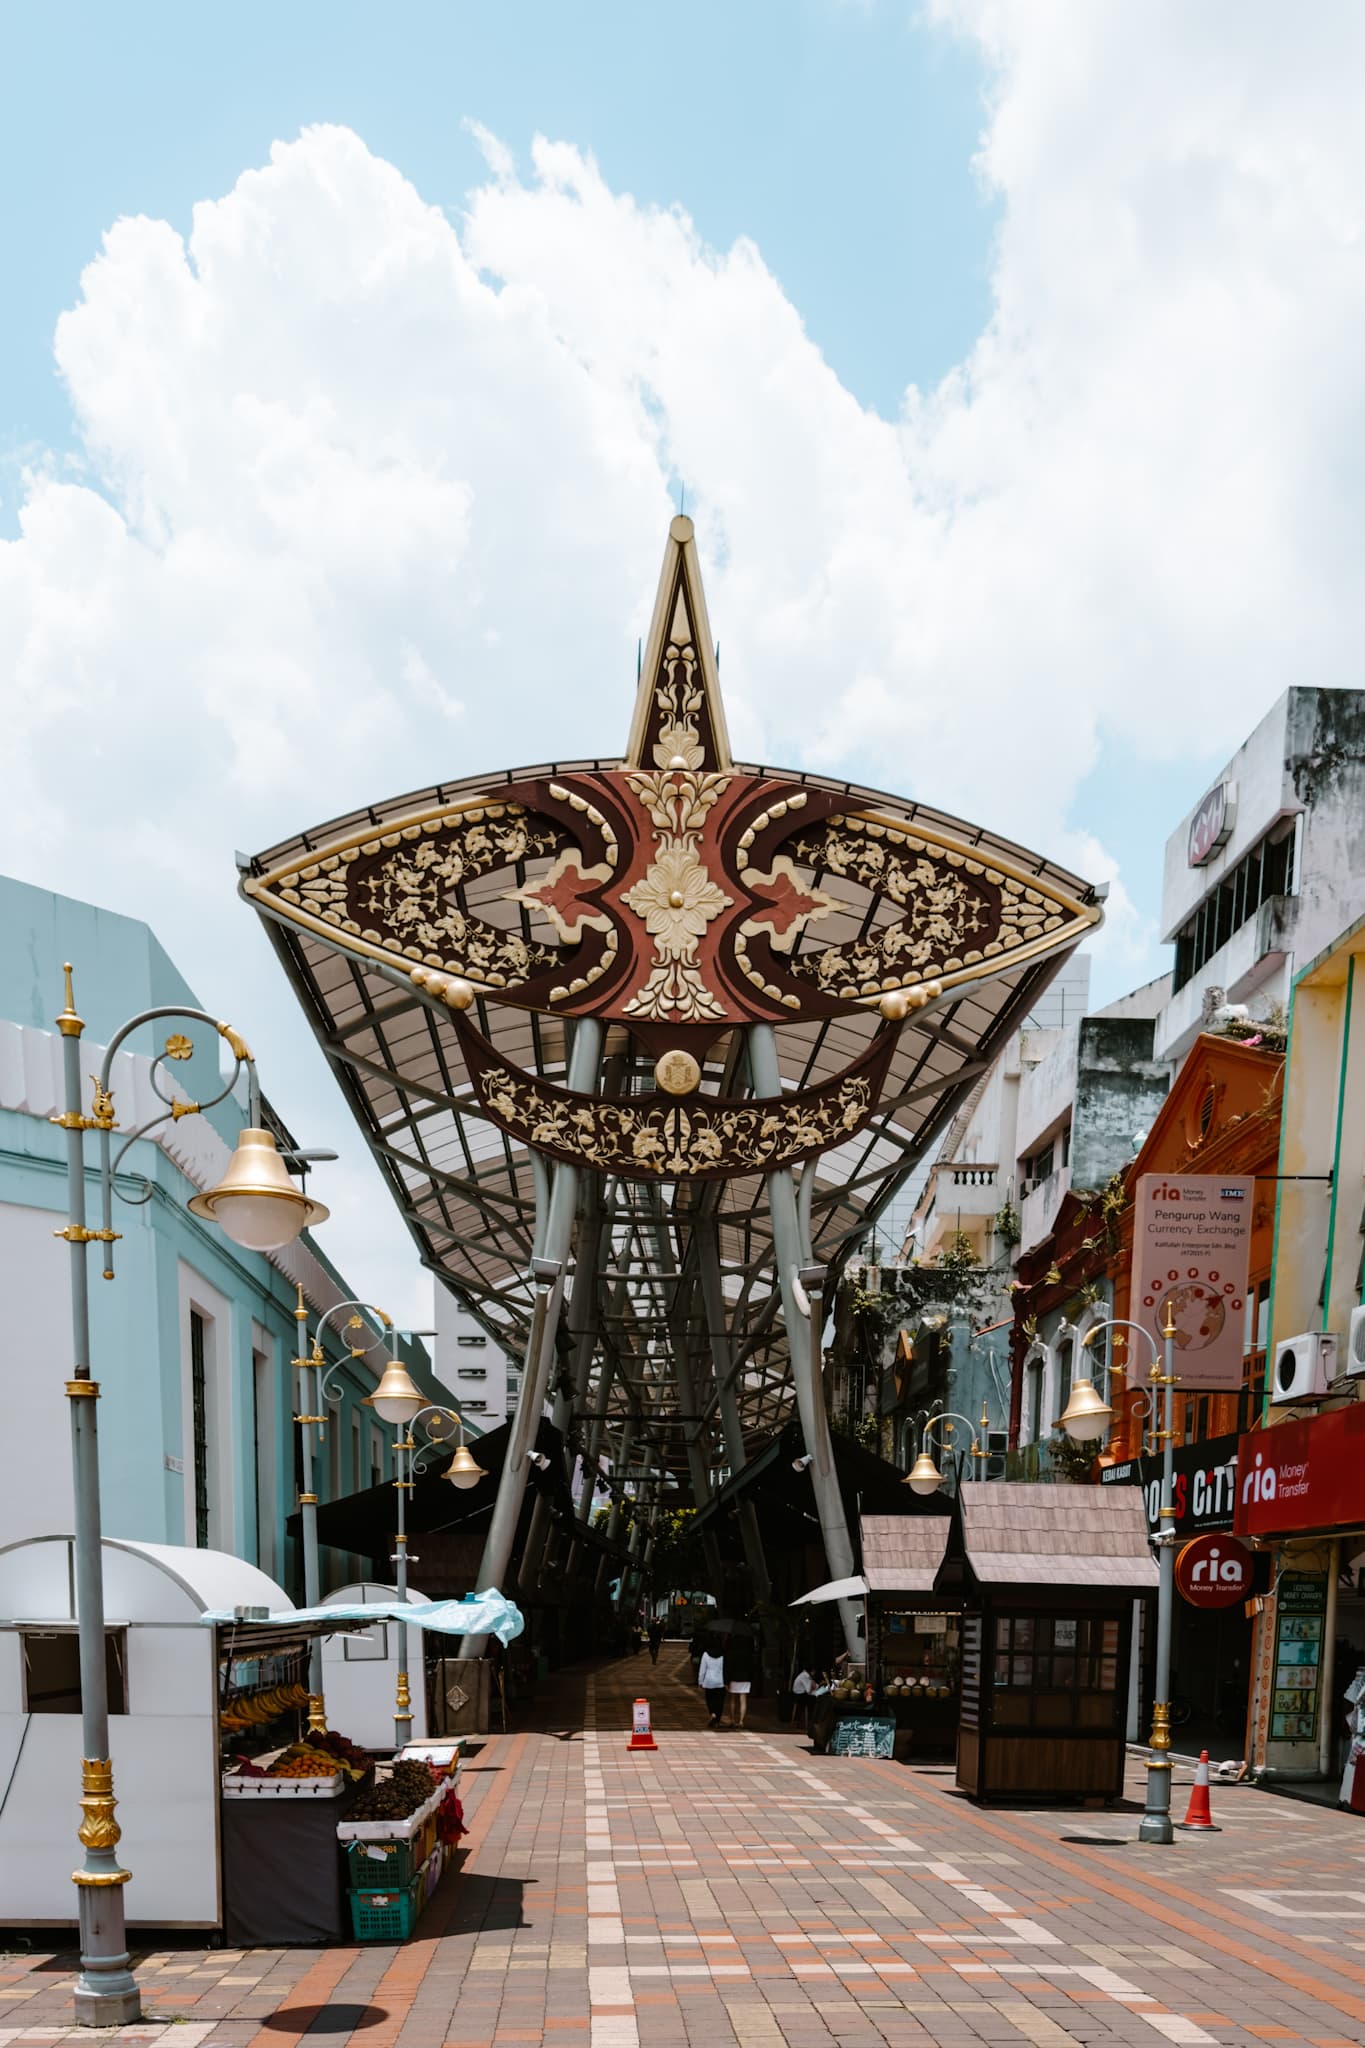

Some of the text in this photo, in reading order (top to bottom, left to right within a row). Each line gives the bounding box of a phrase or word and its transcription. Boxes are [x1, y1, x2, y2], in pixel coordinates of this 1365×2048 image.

[1152, 1182, 1180, 1200] ria
[1155, 1210, 1240, 1223] Pengurup Wang
[1148, 1224, 1246, 1237] Currency Exchange
[1102, 1464, 1132, 1483] KEDAI KASUT
[1242, 1453, 1276, 1504] ria
[1280, 1464, 1306, 1483] Money
[1278, 1481, 1309, 1498] Transfer
[1192, 1548, 1242, 1581] ria
[1190, 1584, 1213, 1592] Money
